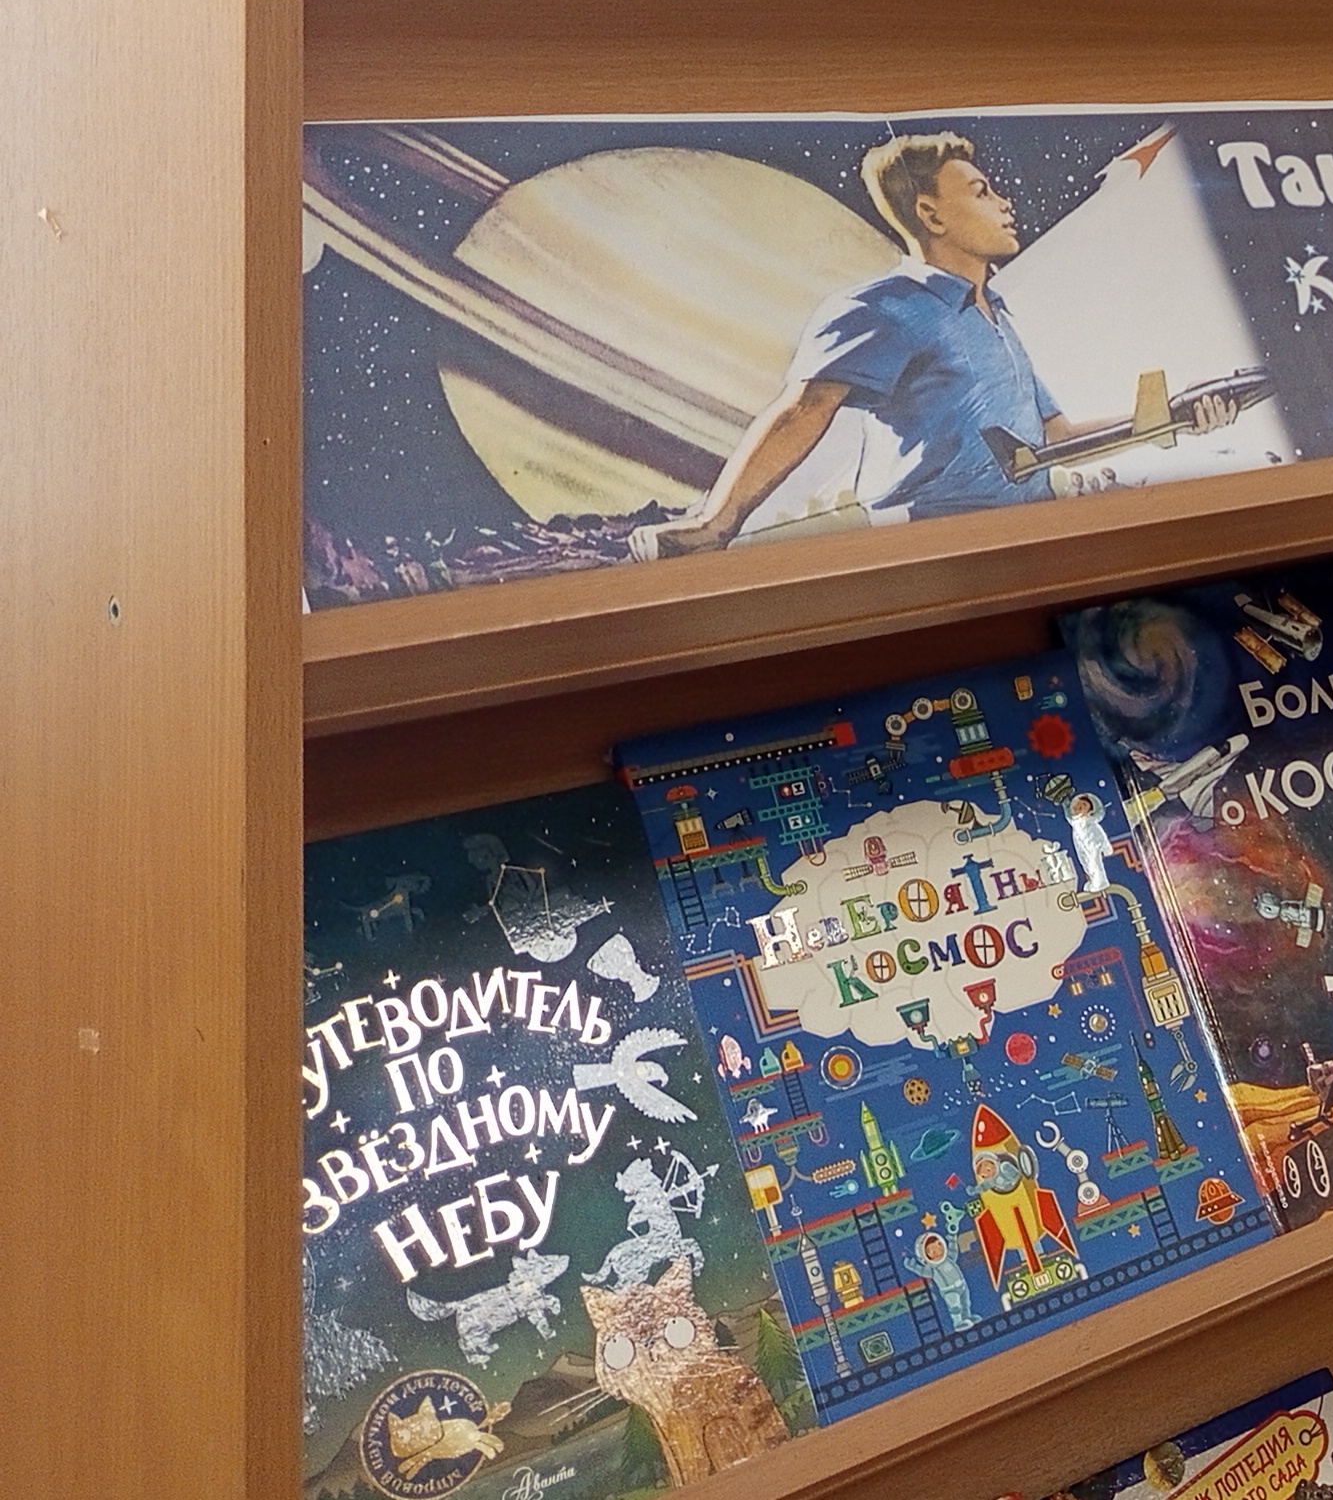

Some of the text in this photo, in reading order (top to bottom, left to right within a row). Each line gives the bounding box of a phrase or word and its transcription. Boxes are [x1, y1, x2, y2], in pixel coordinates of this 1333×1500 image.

[1221, 800, 1245, 826] о
[827, 917, 1039, 1009] КОСМОС
[385, 1047, 464, 1114] ПО
[302, 1084, 616, 1235] ЗВЁЗДНОМУ
[373, 1170, 561, 1283] НЕБУ
[502, 1465, 578, 1500] Аванта
[1268, 1453, 1309, 1492] САДА
